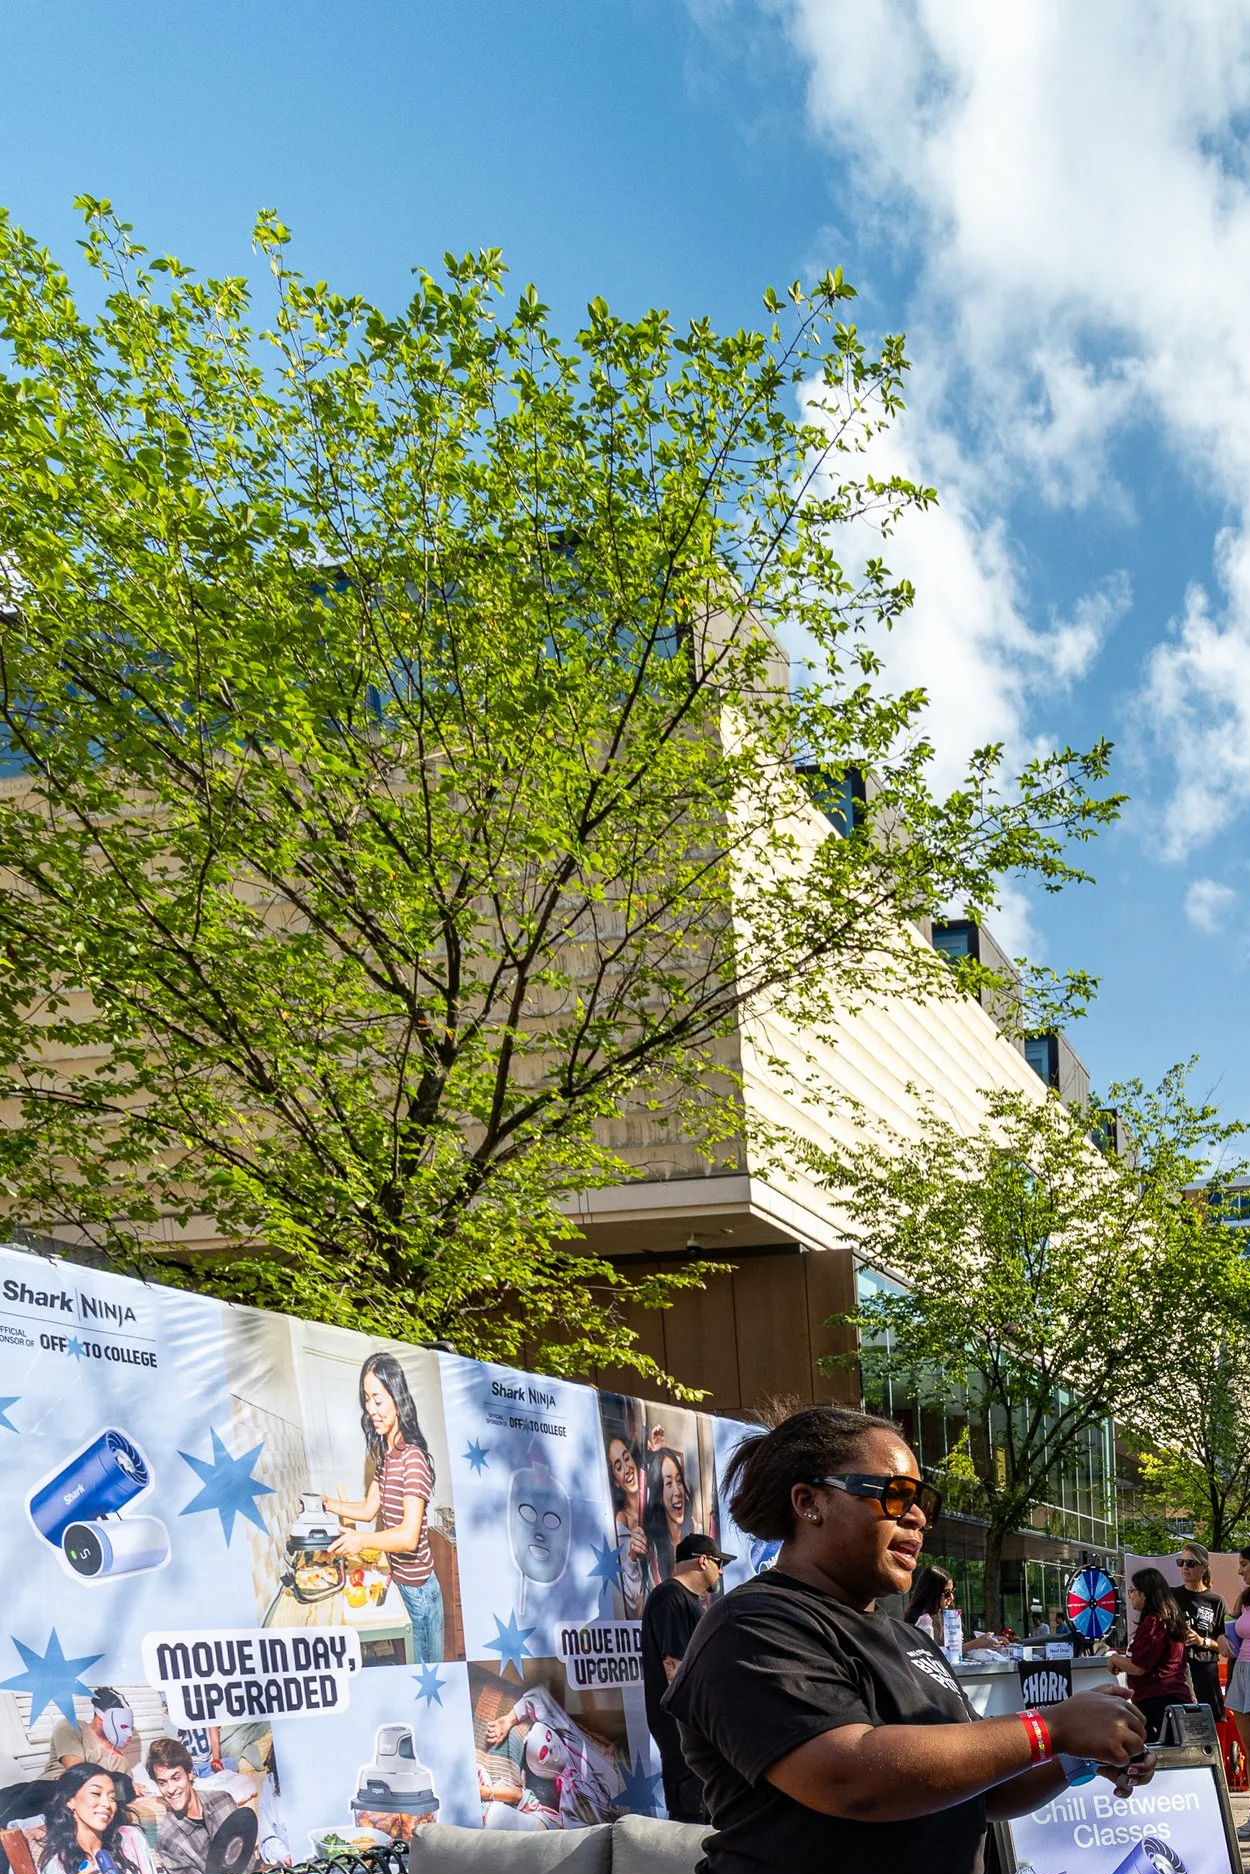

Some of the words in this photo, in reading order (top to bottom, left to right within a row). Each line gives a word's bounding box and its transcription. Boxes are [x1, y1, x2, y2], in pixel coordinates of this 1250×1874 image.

[2, 1279, 74, 1313] Shark
[80, 1292, 137, 1328] NINJA
[0, 1325, 27, 1338] FFICIAL
[0, 1334, 25, 1346] ONSOR
[25, 1338, 36, 1348] OF
[40, 1333, 67, 1352] OFF
[82, 1341, 101, 1359] TO
[104, 1346, 158, 1368] COLLEGE
[491, 1381, 526, 1402] Shark
[528, 1386, 557, 1410] NINJA
[509, 1416, 523, 1430] OFF
[529, 1420, 540, 1433] TO
[540, 1422, 567, 1438] COLLEGE
[63, 1483, 86, 1506] Shark
[259, 1638, 289, 1674] IN
[292, 1635, 356, 1672] DAY,
[614, 1627, 632, 1654] IN
[574, 1655, 644, 1686] UPGRAD
[181, 1674, 338, 1722] UPGRADED
[1023, 1671, 1069, 1704] SHARK
[1093, 1791, 1201, 1820] Between
[1072, 1821, 1173, 1849] Classes
